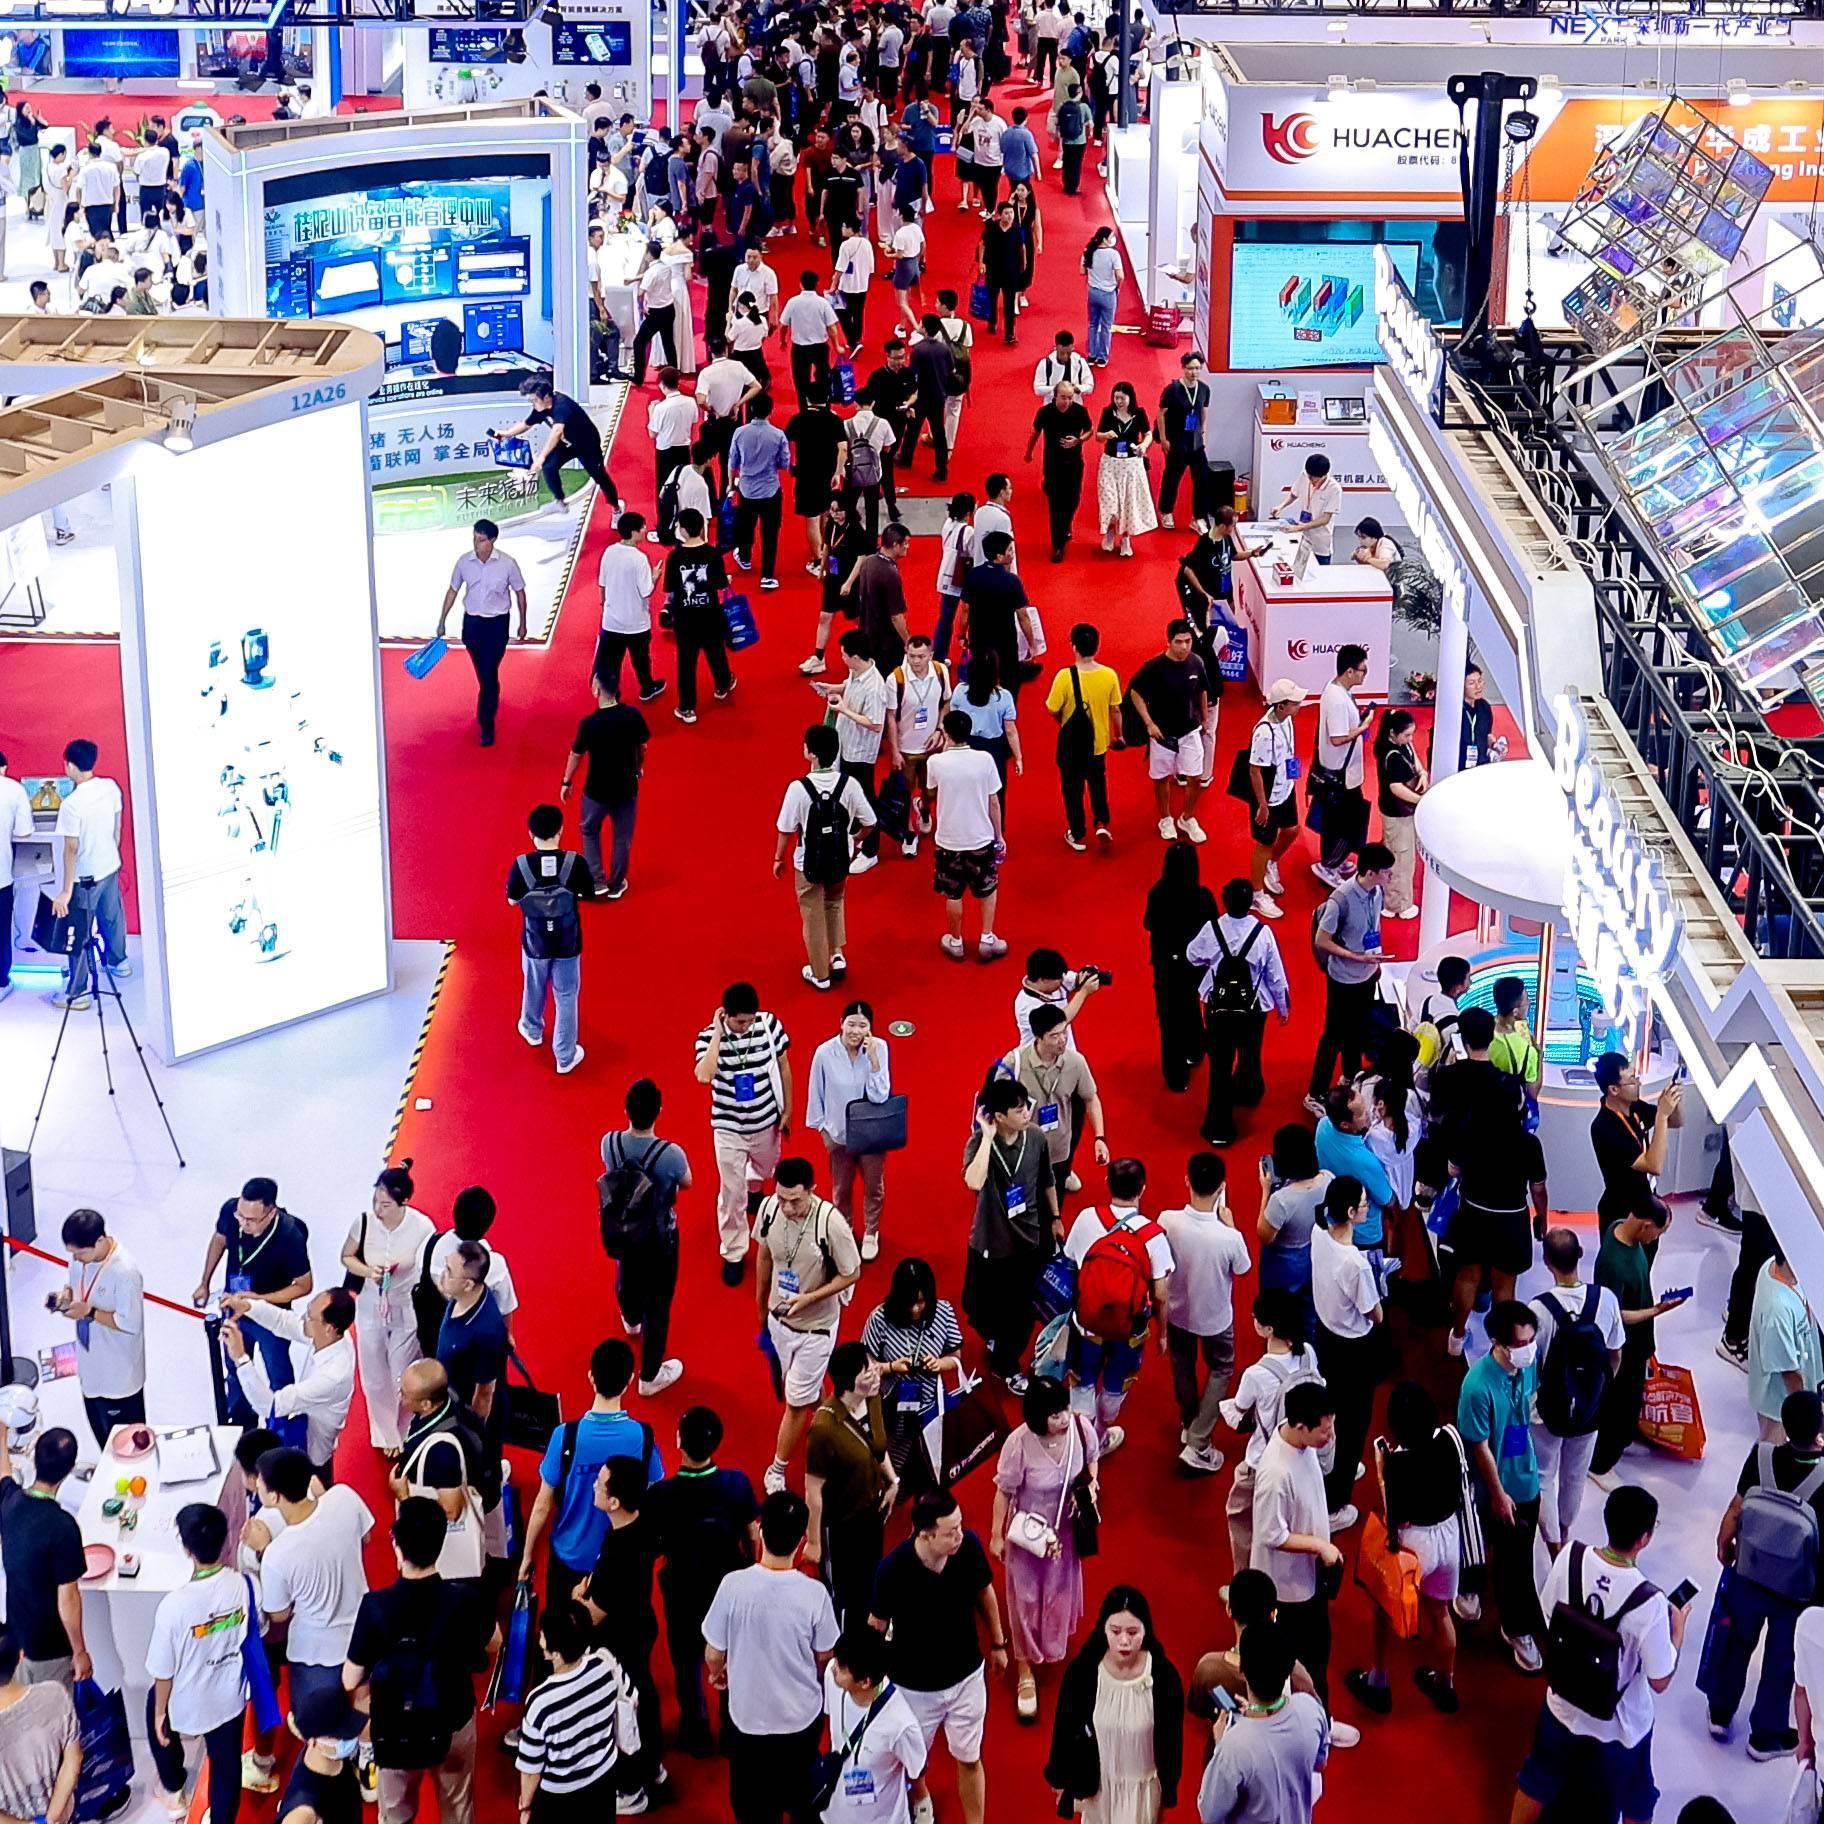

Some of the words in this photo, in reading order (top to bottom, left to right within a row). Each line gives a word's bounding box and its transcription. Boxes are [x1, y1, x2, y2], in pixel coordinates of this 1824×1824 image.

[1550, 9, 1626, 43] NEXT
[1333, 127, 1471, 148] HUACHEN
[291, 382, 347, 412] 12A26
[398, 422, 455, 445] 无人场
[1287, 441, 1326, 449] HUACHENG
